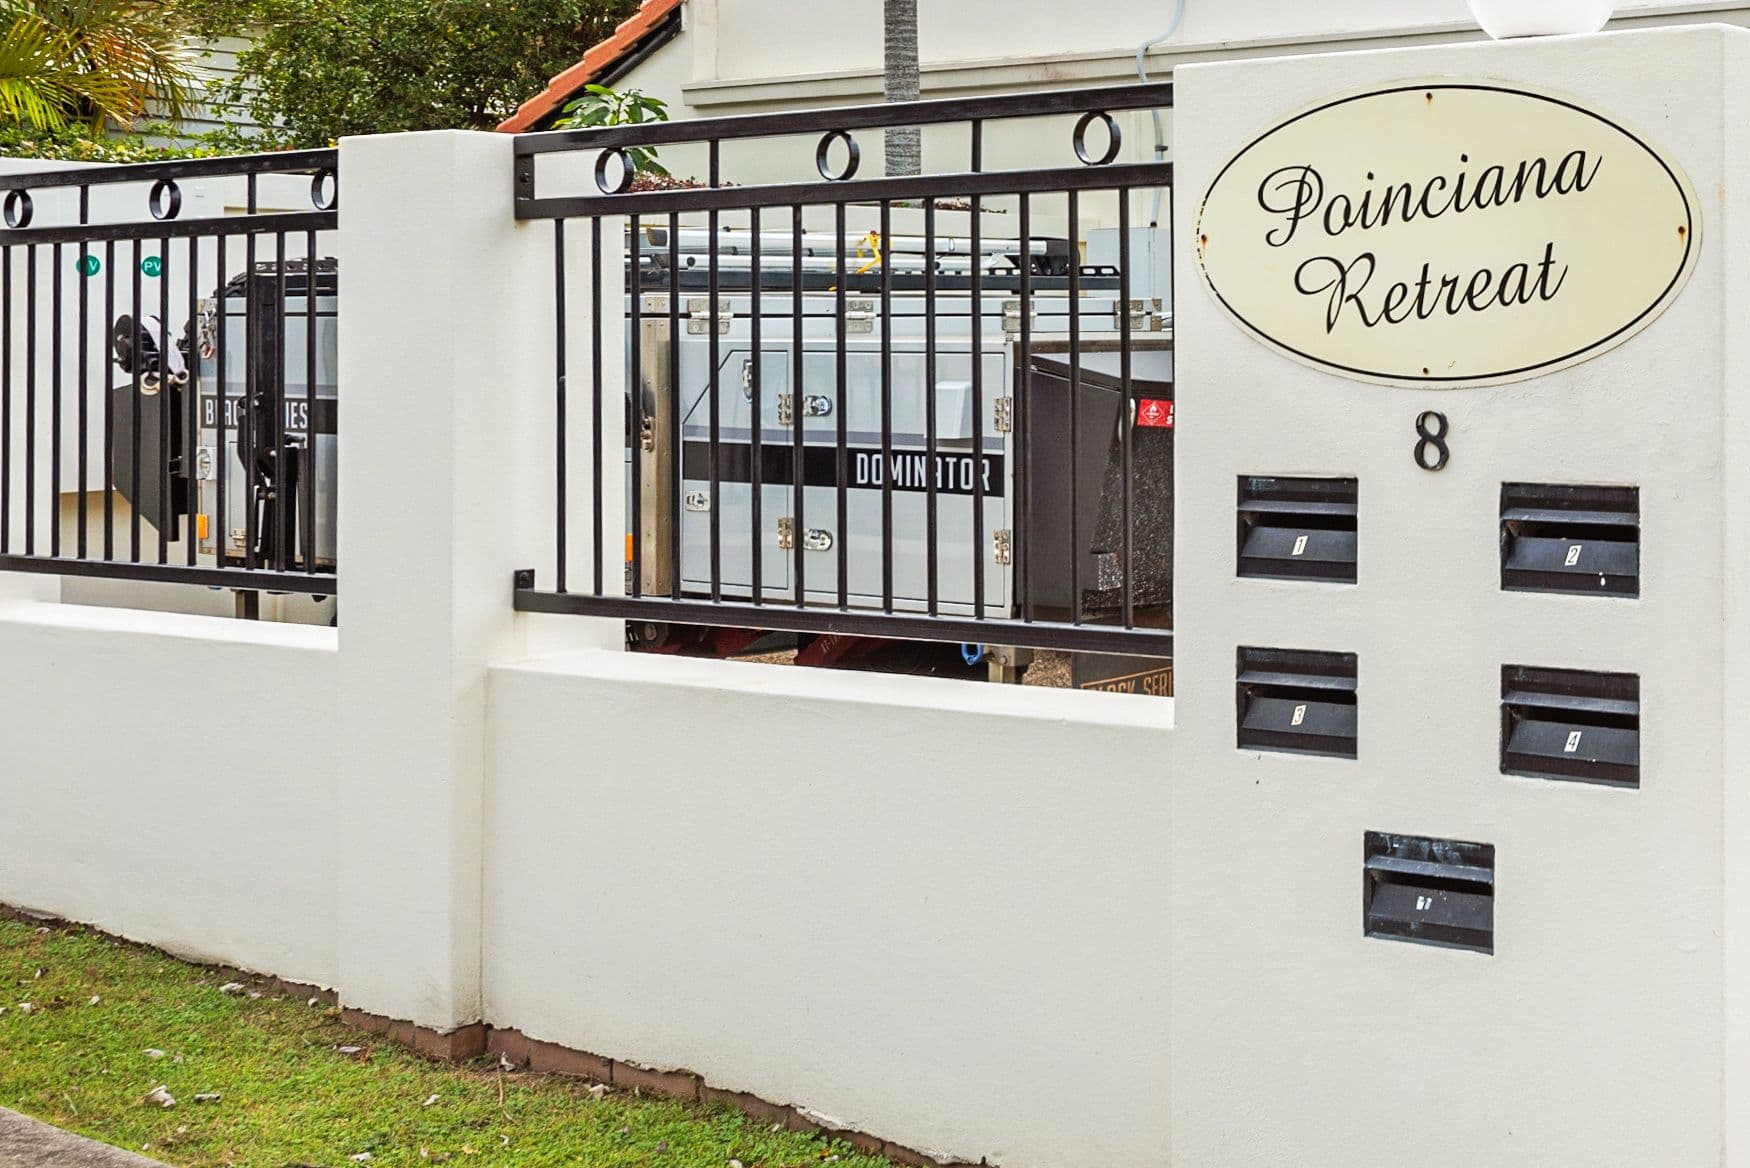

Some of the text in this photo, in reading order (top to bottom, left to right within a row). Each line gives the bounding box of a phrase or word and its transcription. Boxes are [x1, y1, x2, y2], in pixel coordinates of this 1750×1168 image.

[1257, 150, 1603, 247] Poinciana
[1294, 241, 1568, 335] Retreat
[856, 453, 990, 491] DOMINATOR
[1413, 410, 1450, 472] 8
